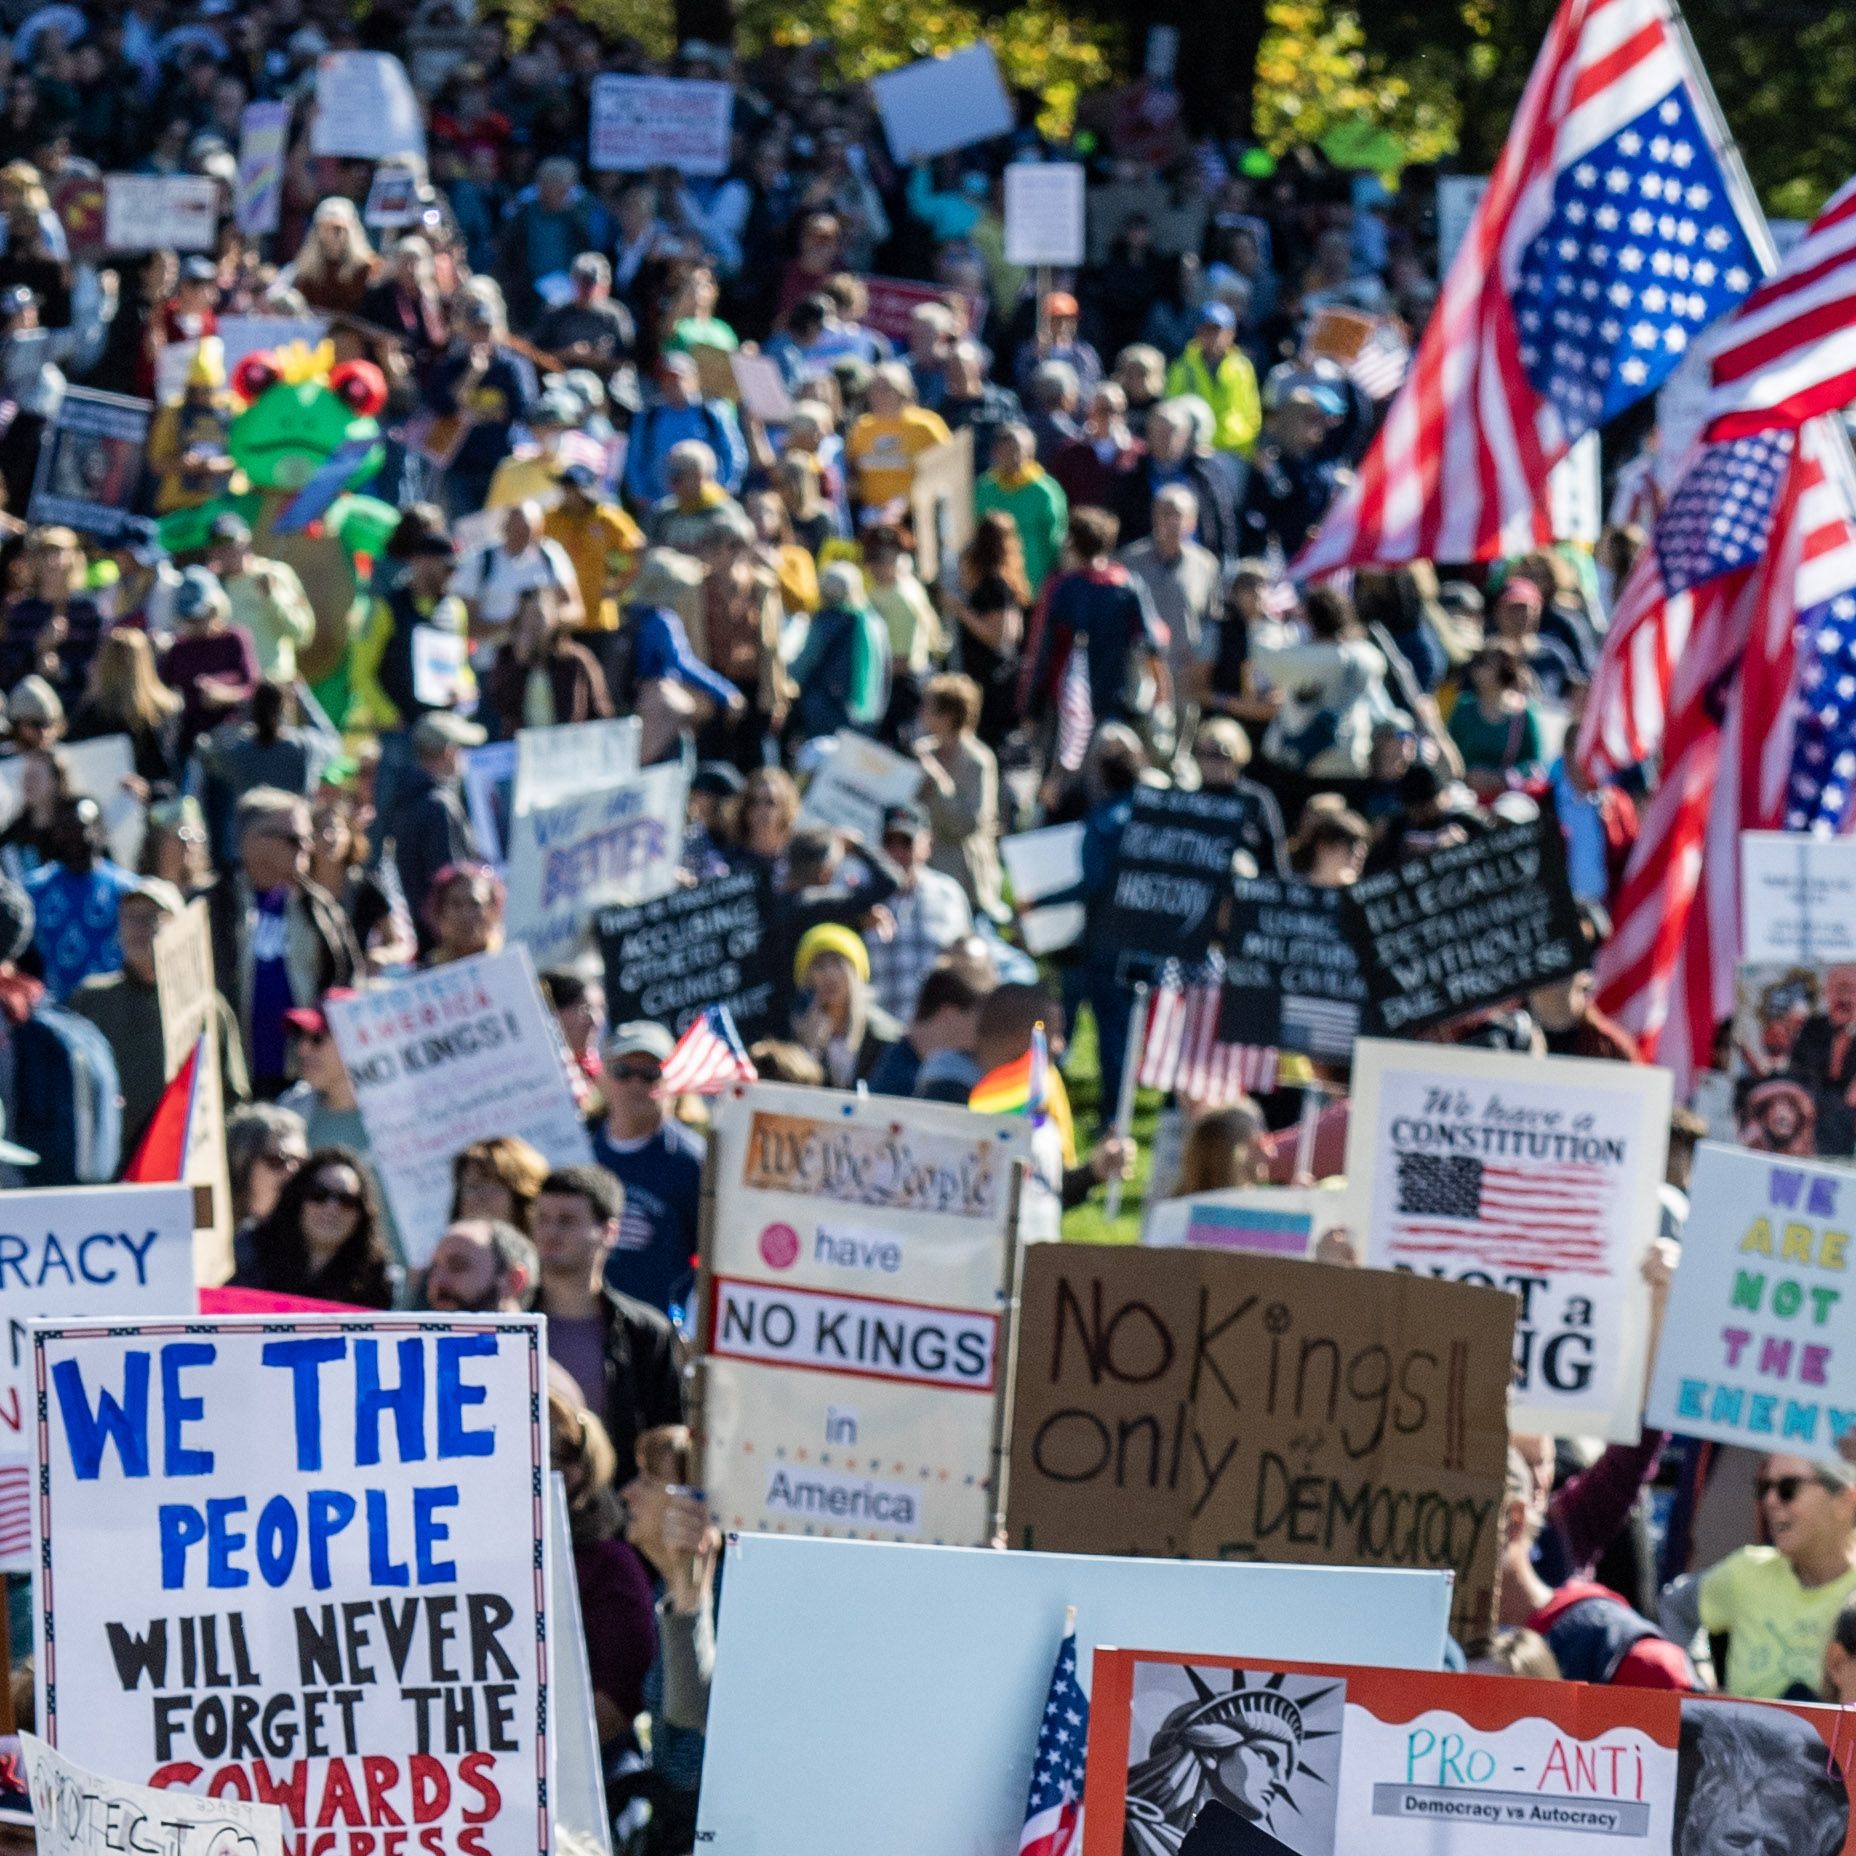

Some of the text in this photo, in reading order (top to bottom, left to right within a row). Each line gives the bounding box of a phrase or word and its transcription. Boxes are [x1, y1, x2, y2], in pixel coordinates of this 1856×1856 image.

[1365, 846, 1540, 933] ILLEGALLY
[1374, 889, 1550, 967] DETAINING
[1390, 915, 1551, 990] WITHOUT
[1446, 940, 1573, 1004] PROCESS
[1391, 1118, 1626, 1163] CONSTITUTION
[874, 1136, 994, 1208] People
[1768, 1168, 1838, 1219] WE
[814, 1226, 903, 1273] have
[1739, 1218, 1852, 1272] ARE
[1563, 1295, 1592, 1327] a
[1731, 1270, 1842, 1326] NOT
[723, 1298, 987, 1376] NO KINGS
[1720, 1327, 1835, 1386] THE
[52, 1334, 500, 1480] WE THE
[826, 1409, 858, 1444] in
[766, 1470, 916, 1524] America
[159, 1486, 460, 1591] PEOPLE
[106, 1594, 521, 1691] WILL NEVER
[153, 1684, 521, 1762] FORGET THE
[1407, 1728, 1496, 1787] PRO
[1405, 1796, 1618, 1828] Democracy vs Autocracy
